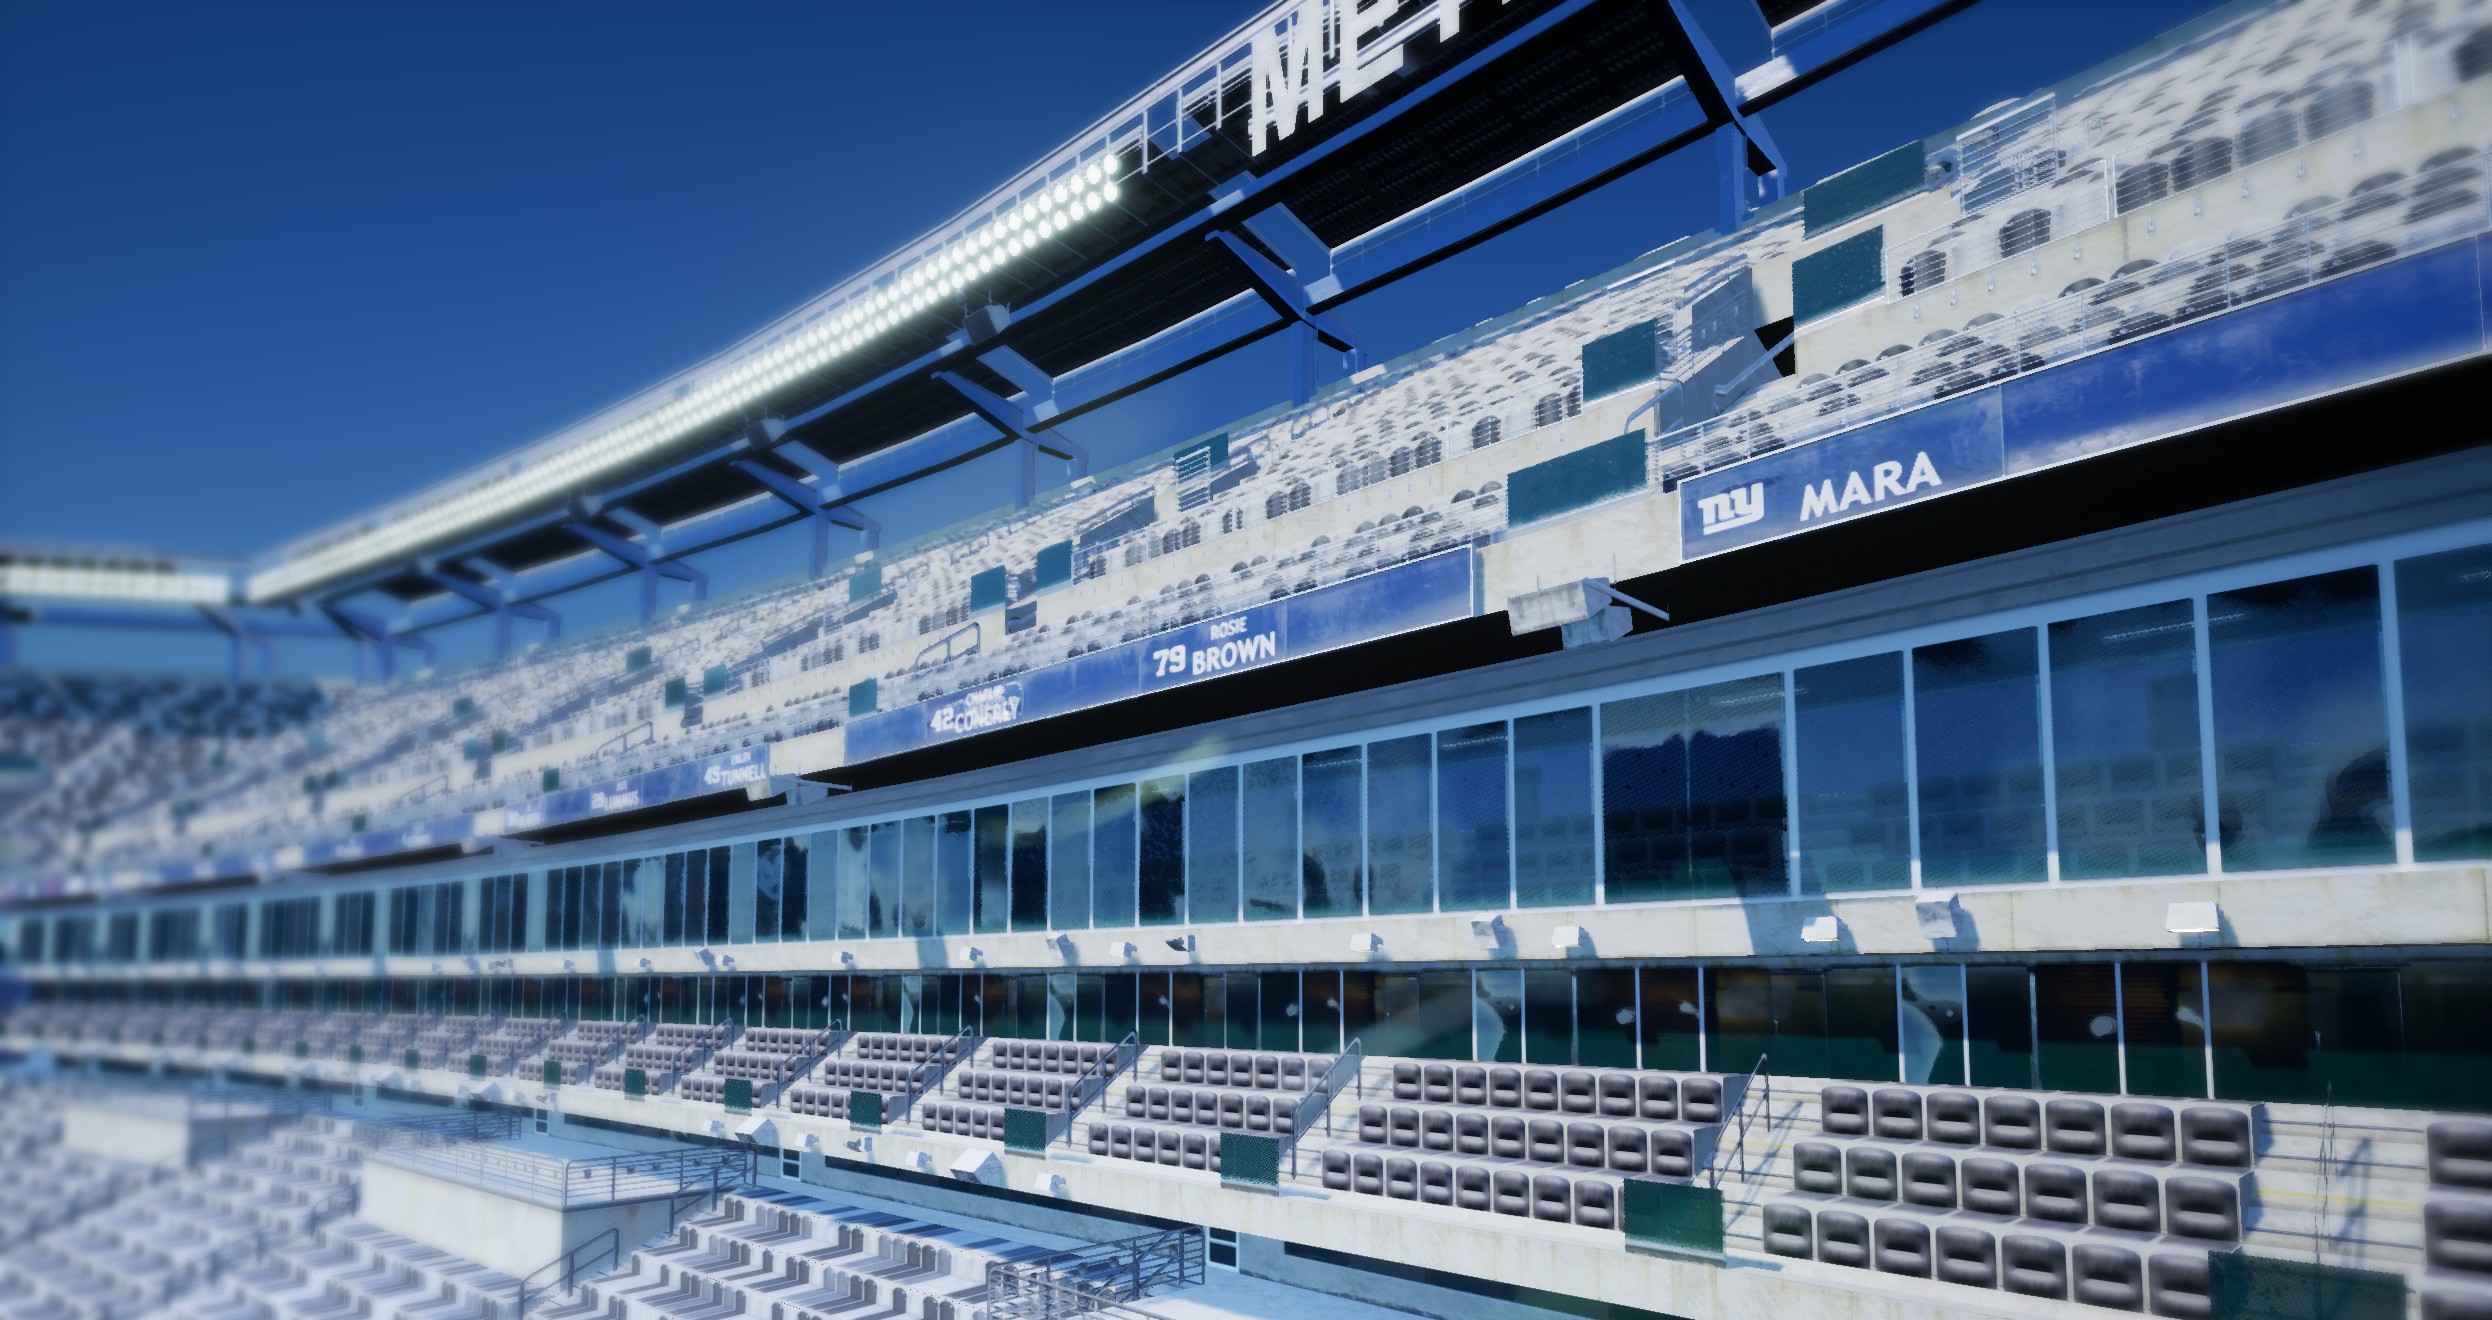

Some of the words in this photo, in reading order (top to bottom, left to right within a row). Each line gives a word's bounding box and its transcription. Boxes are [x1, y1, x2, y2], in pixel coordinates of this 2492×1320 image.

[1799, 450, 1943, 522] MARA
[1210, 616, 1248, 640] ROSIE
[1153, 644, 1187, 678] 79
[1192, 631, 1276, 675] BROWN
[930, 706, 954, 732] 42
